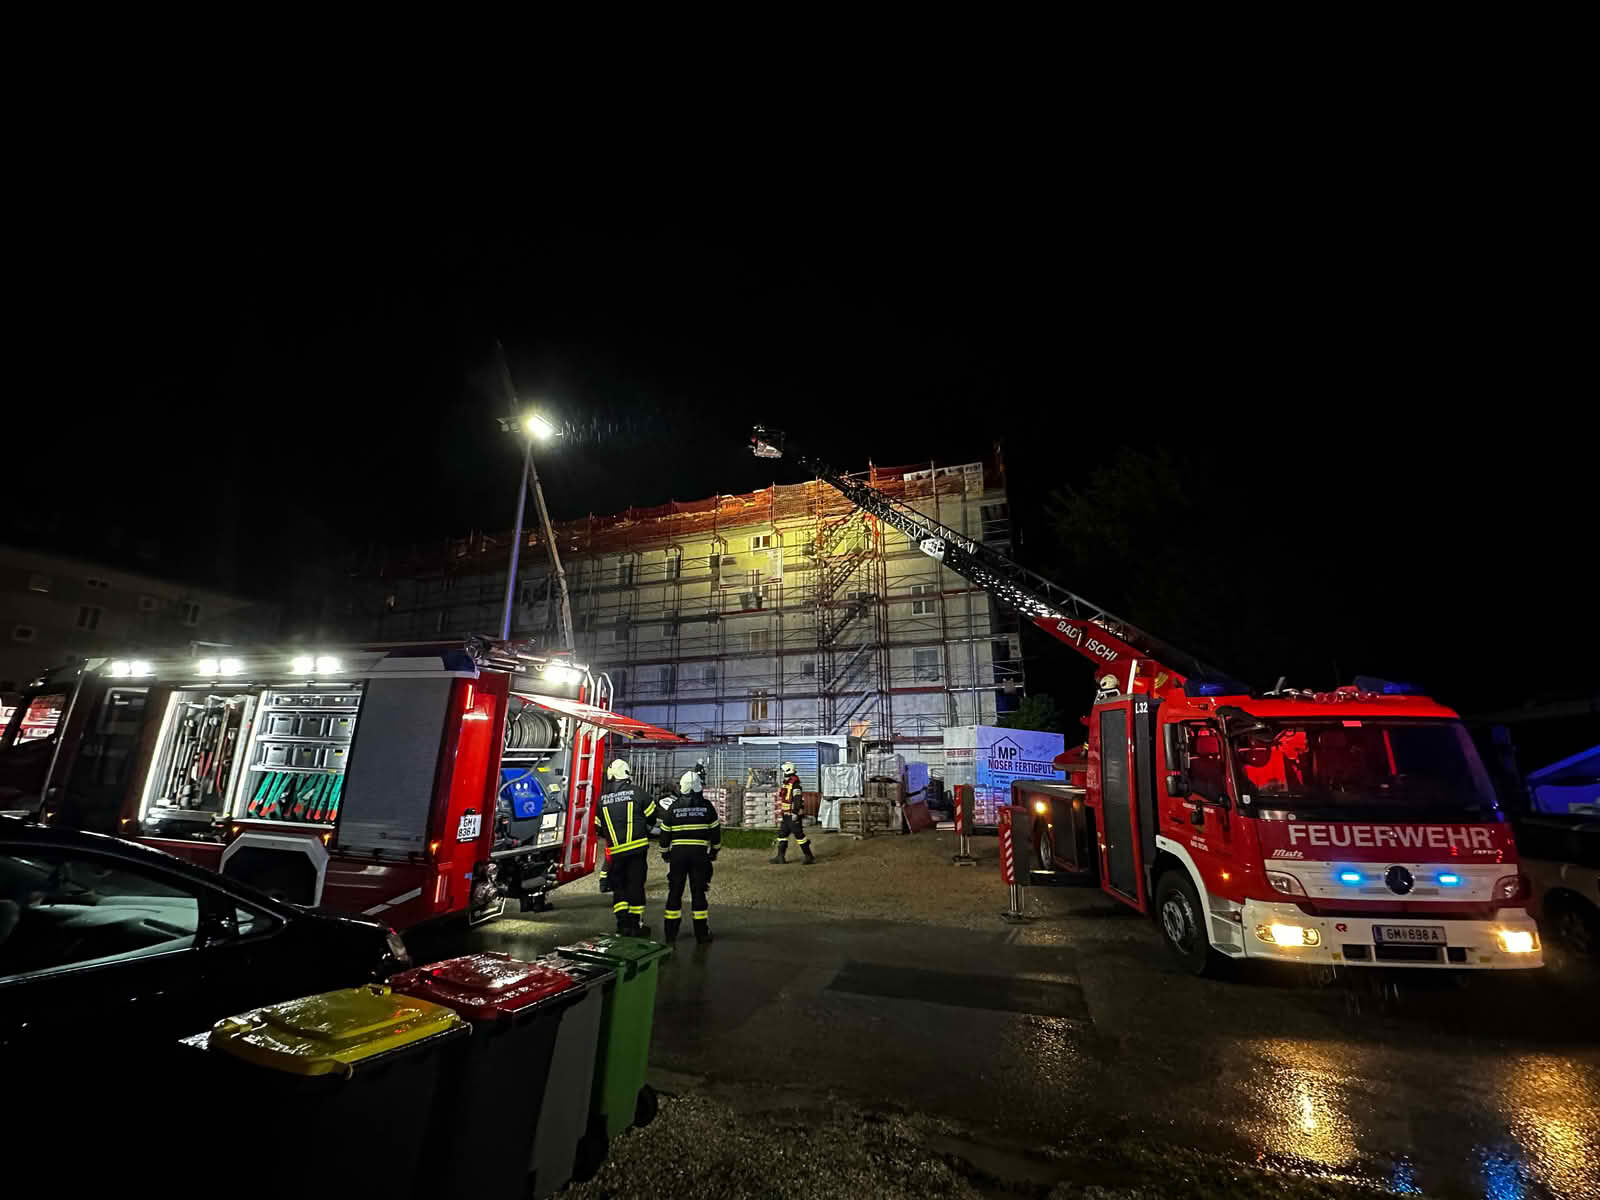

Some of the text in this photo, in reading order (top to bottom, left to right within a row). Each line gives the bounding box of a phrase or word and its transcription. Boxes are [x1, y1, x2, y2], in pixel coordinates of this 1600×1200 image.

[1056, 621, 1077, 639] BAD
[1135, 702, 1148, 713] L32
[998, 747, 1017, 760] MP
[988, 759, 1013, 771] MOSER
[1288, 824, 1493, 848] FEUERWEHR
